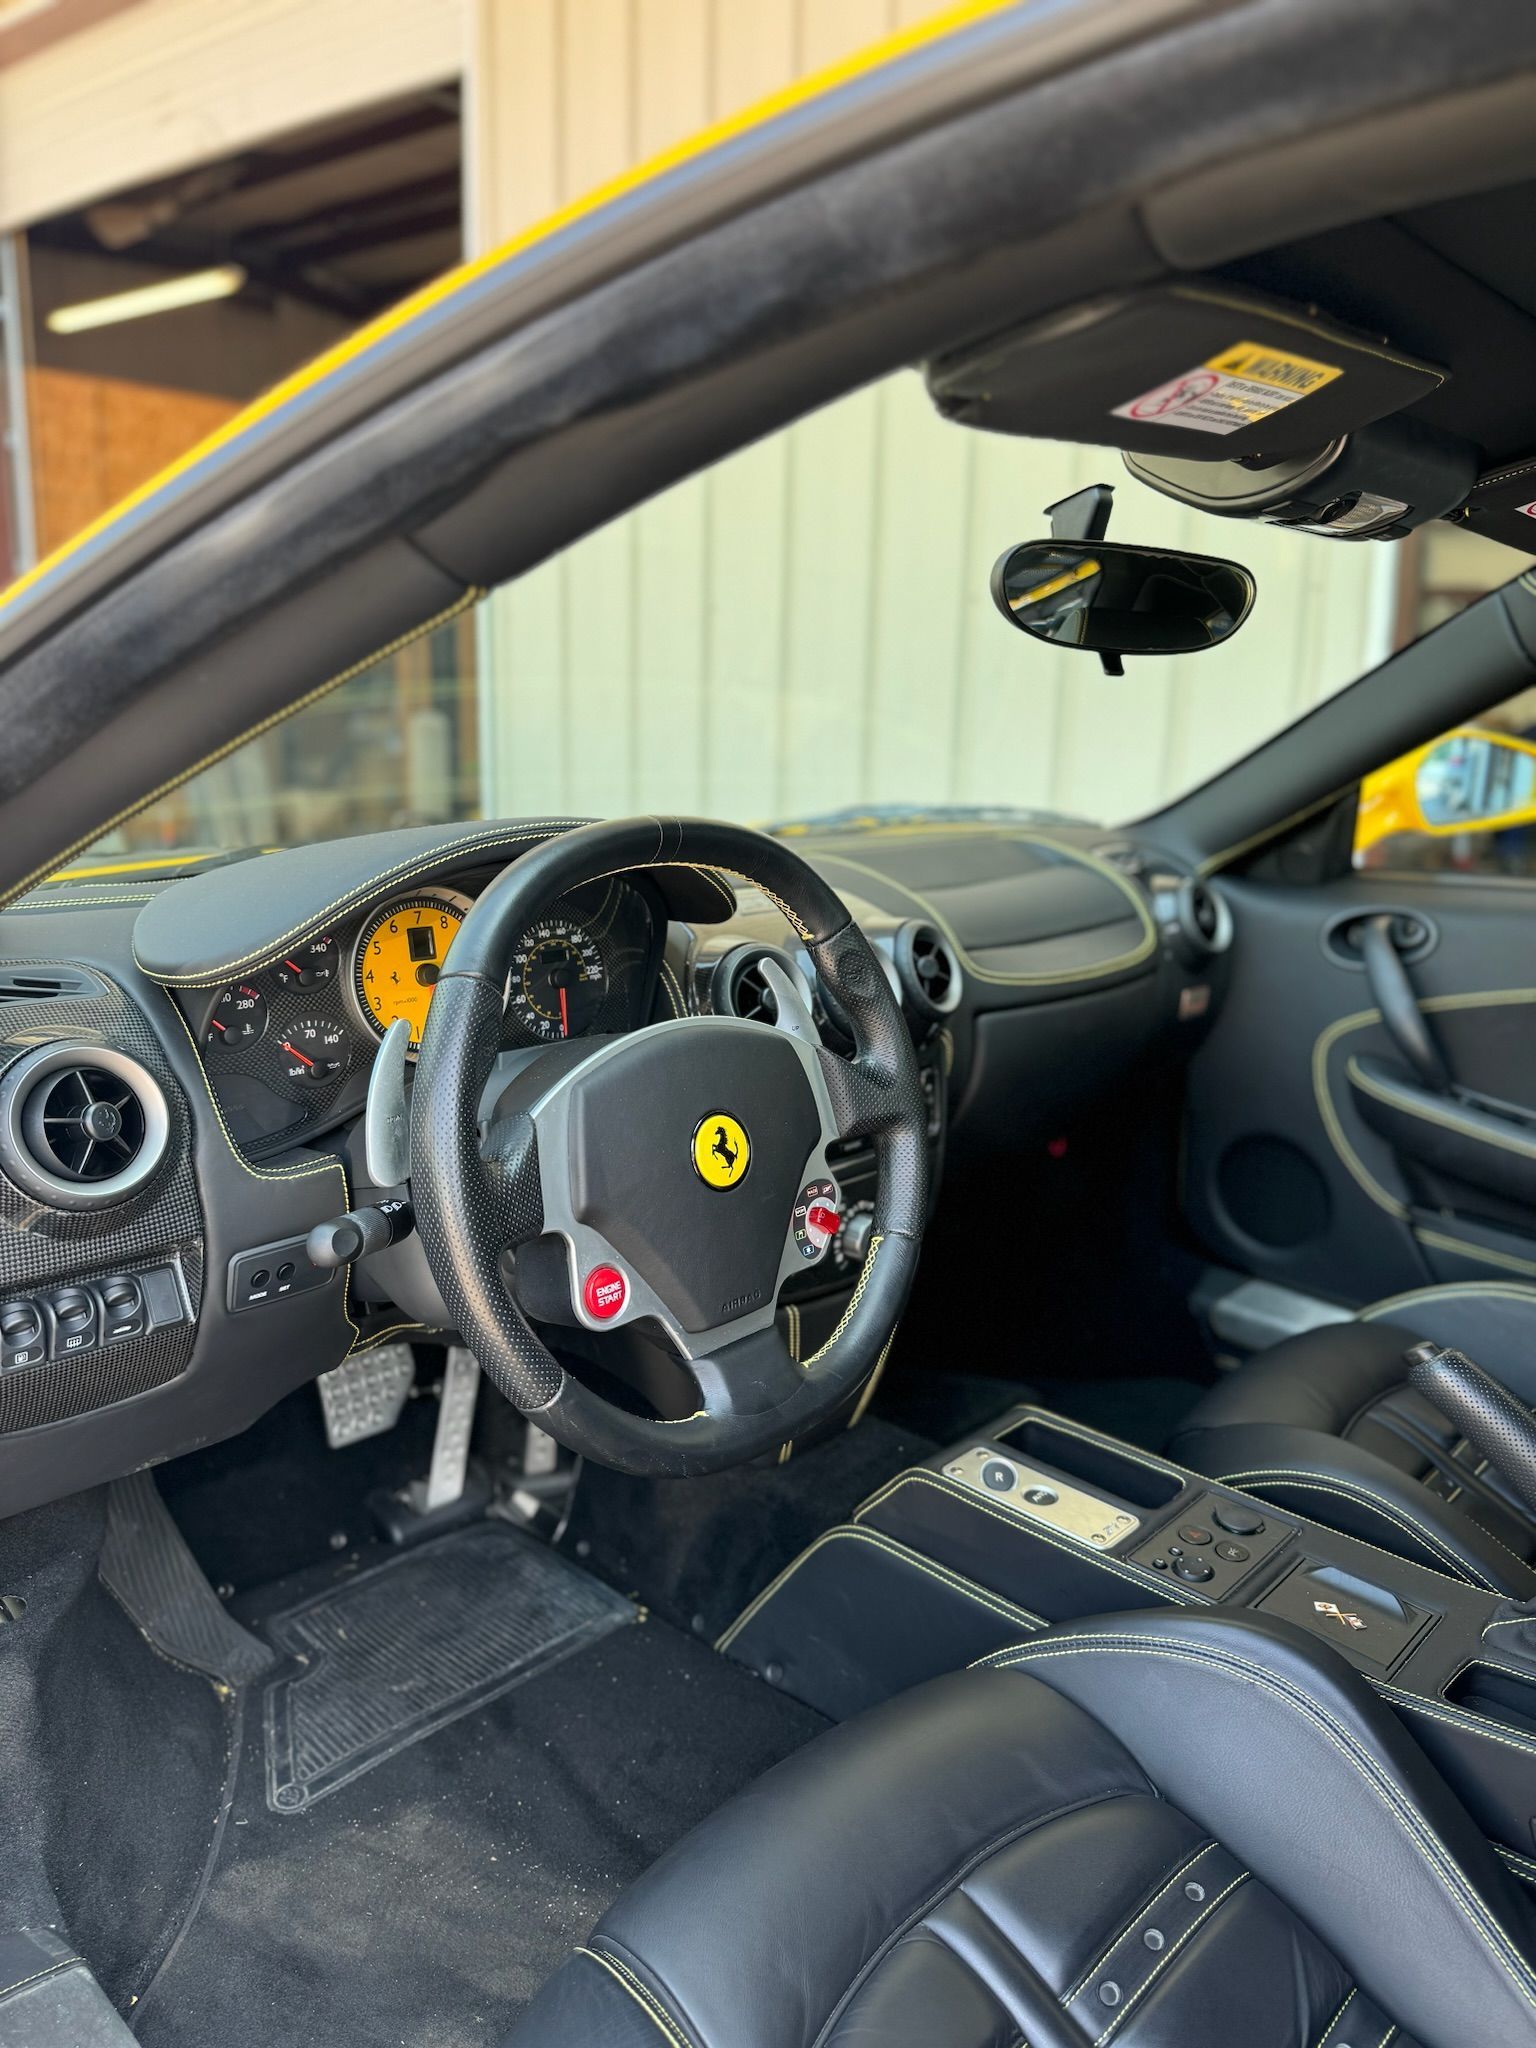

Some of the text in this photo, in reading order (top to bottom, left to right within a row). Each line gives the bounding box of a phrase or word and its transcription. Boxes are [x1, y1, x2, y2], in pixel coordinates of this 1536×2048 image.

[1243, 355, 1325, 389] WARNING
[413, 911, 422, 925] 7
[440, 916, 449, 929] 8
[389, 919, 398, 934] 6
[538, 929, 551, 938] 140
[310, 943, 327, 954] 340
[373, 941, 382, 955] 5
[586, 965, 598, 975] 220
[366, 969, 375, 984] 4
[236, 999, 255, 1010] 280
[374, 997, 382, 1011] 3
[516, 994, 527, 1004] 60
[526, 1011, 535, 1020] 40
[540, 1020, 550, 1030] 20
[304, 1029, 317, 1039] 70
[324, 1034, 339, 1045] 140
[596, 1280, 622, 1297] ENGINE
[597, 1290, 622, 1307] START
[994, 1472, 1003, 1482] R
